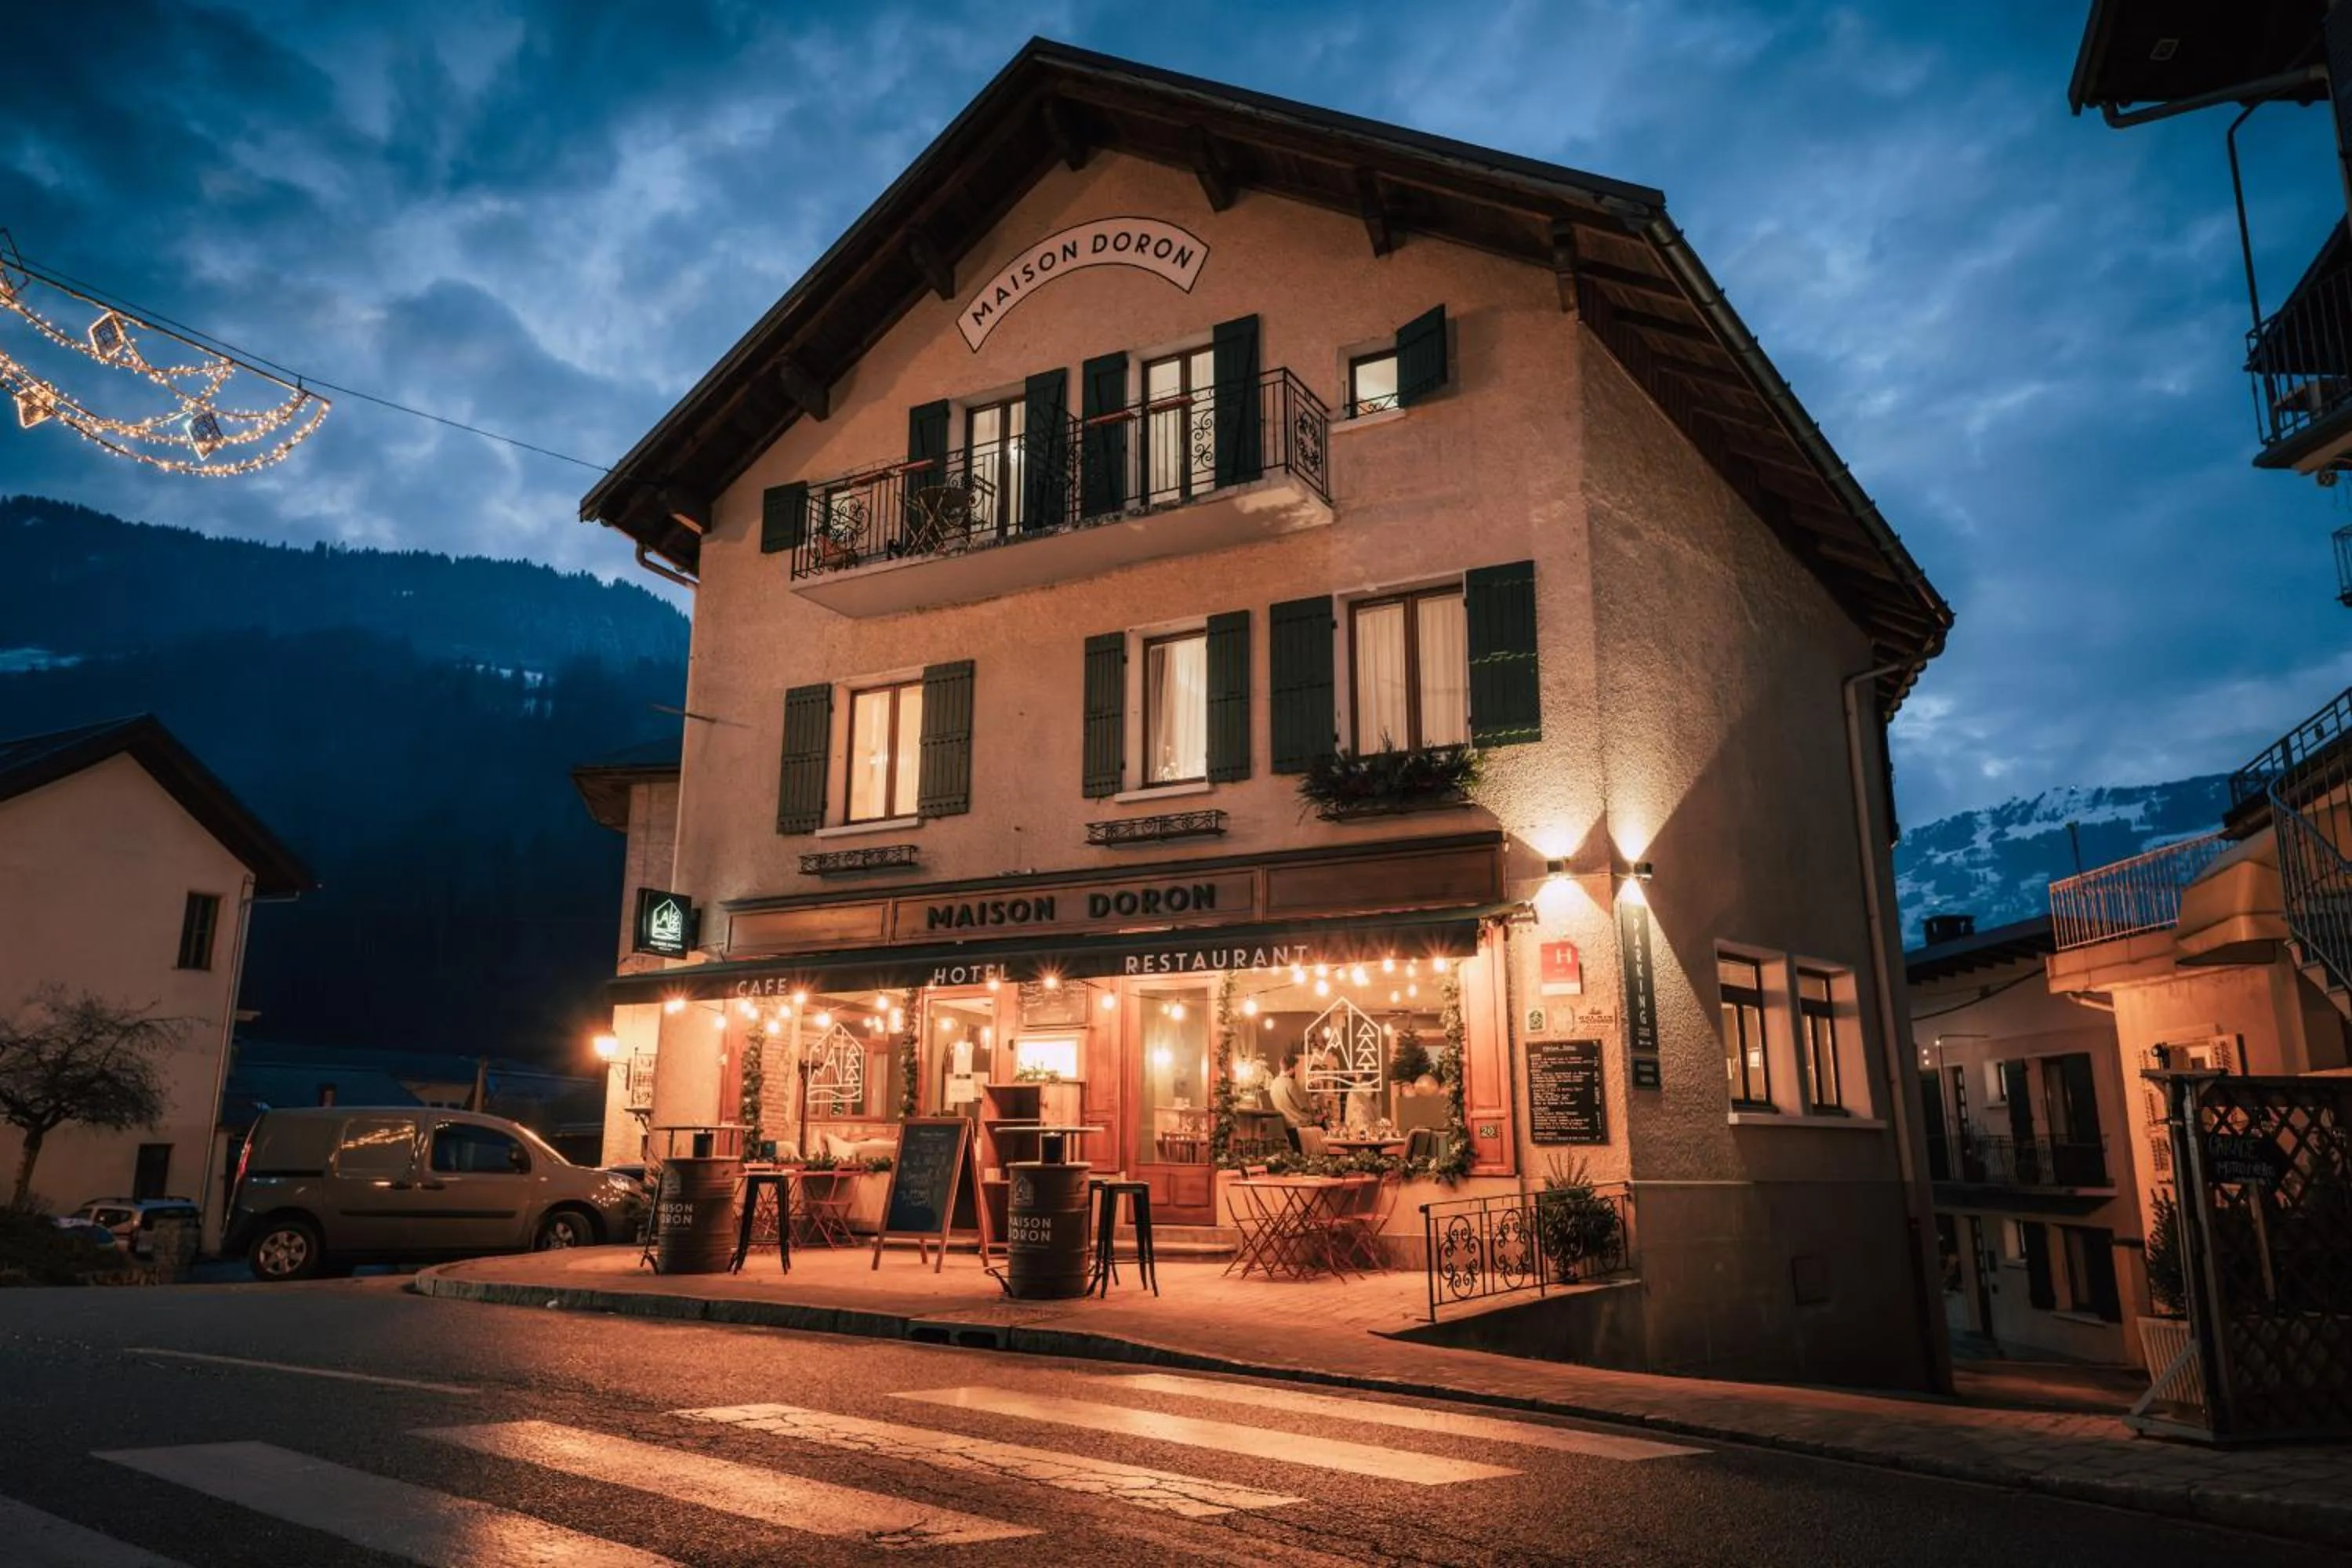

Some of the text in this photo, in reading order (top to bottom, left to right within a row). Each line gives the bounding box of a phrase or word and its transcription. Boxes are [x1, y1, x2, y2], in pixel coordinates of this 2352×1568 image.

[971, 231, 1194, 326] MAISON DORON
[927, 883, 1217, 930] MAISON DORON
[1125, 946, 1308, 974] RESTAURANT
[1555, 948, 1573, 964] H
[933, 964, 1010, 985] HOTEL
[1633, 917, 1647, 1025] PARKING
[737, 978, 788, 996] CAFE
